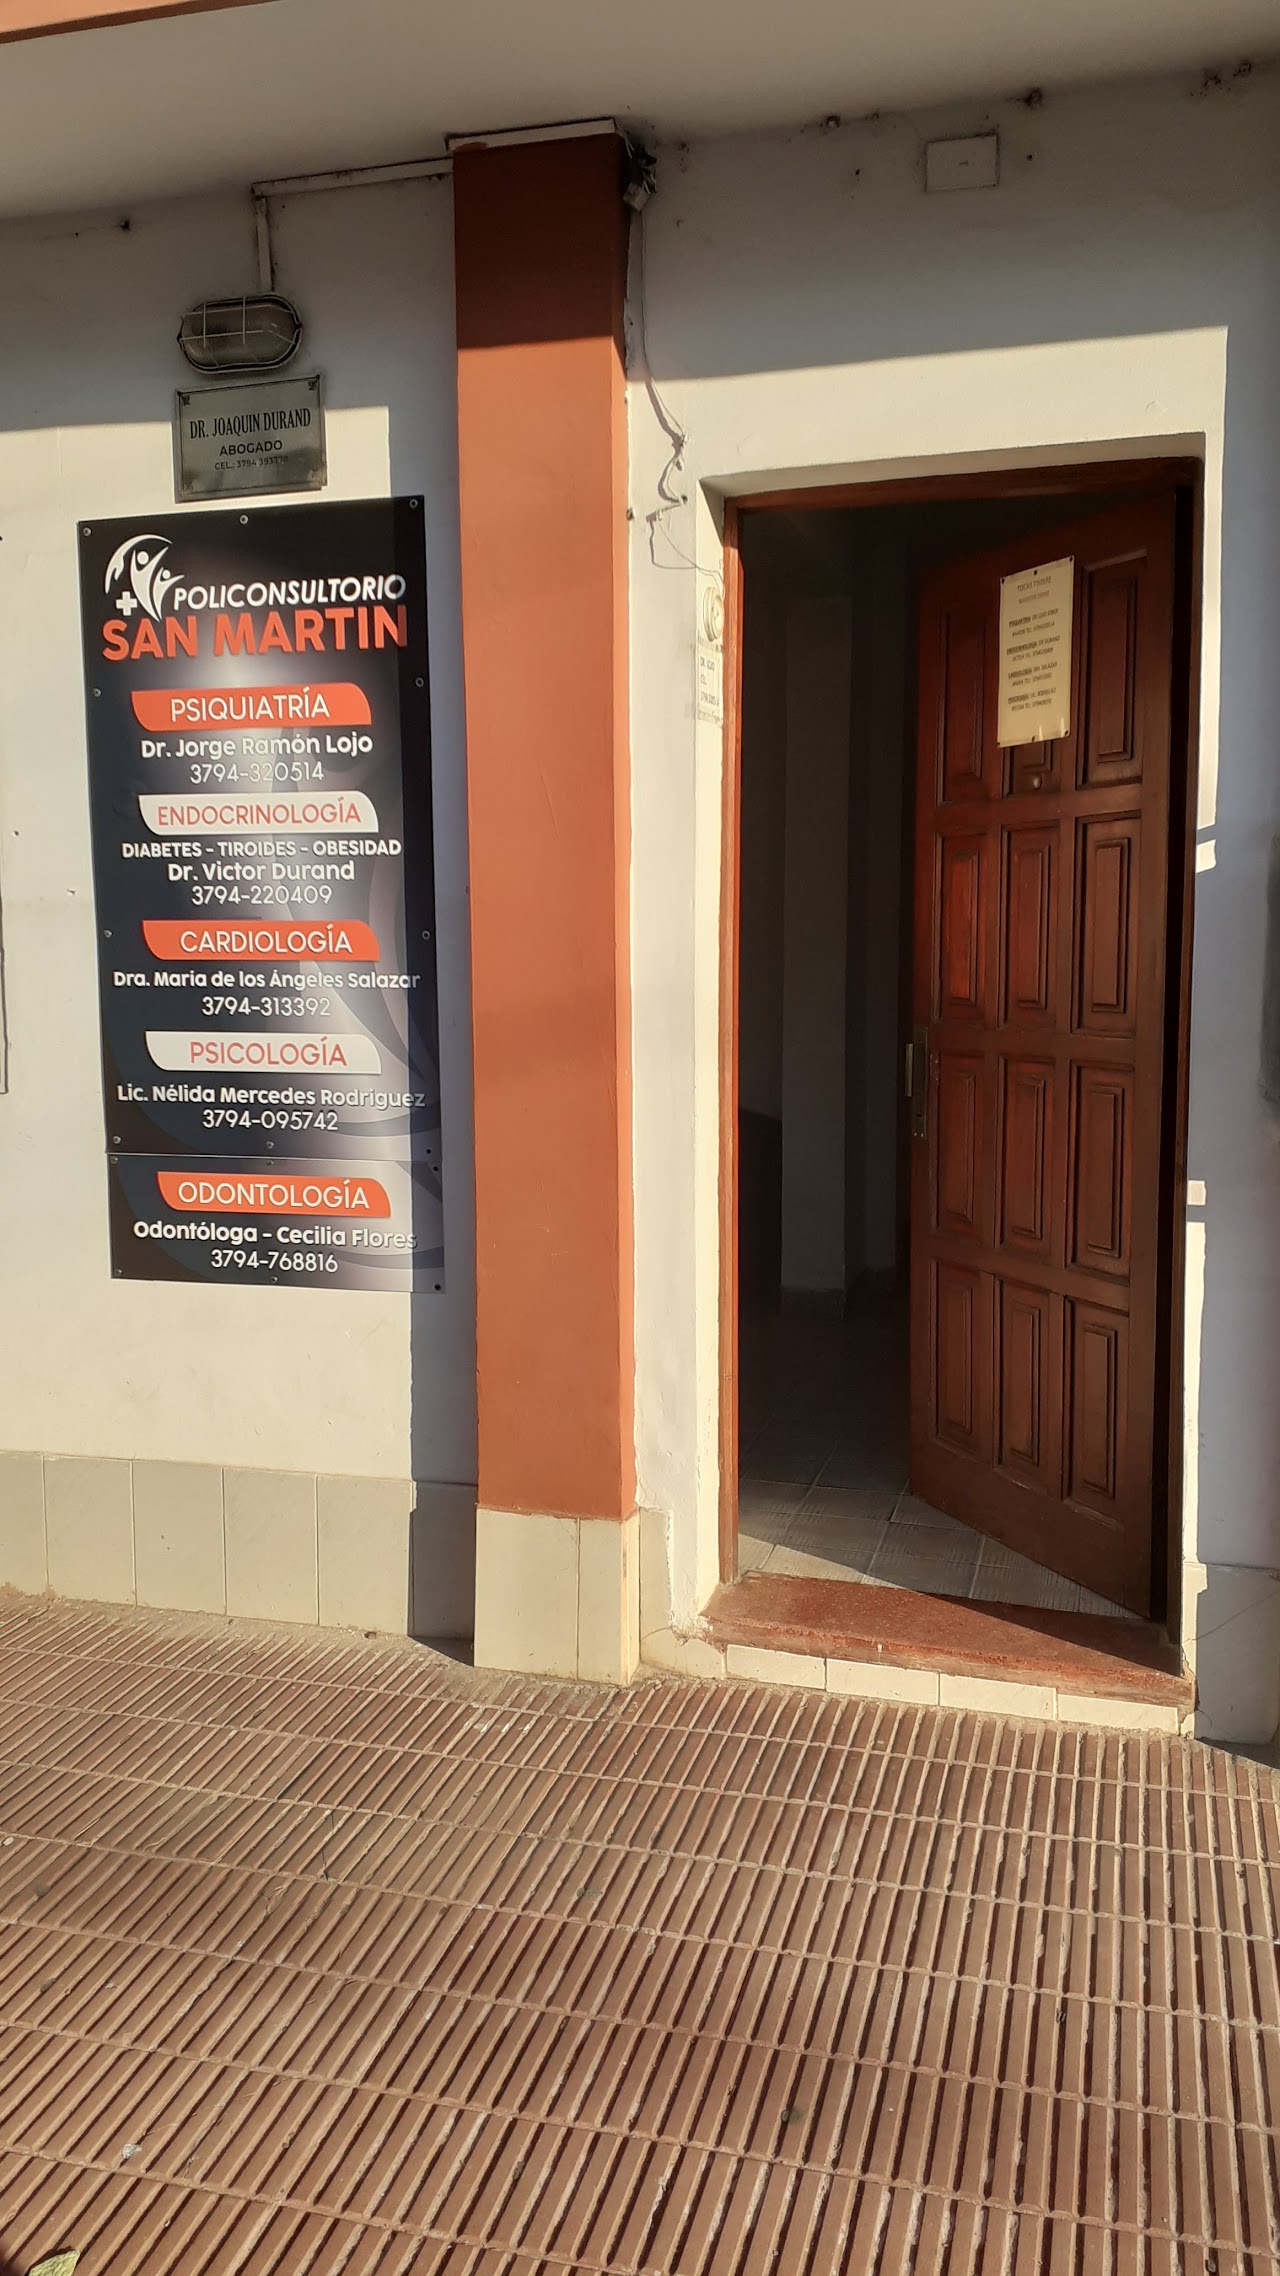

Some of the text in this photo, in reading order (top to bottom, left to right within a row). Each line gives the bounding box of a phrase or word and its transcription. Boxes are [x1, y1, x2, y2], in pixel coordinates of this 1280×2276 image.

[190, 408, 311, 439] DR. JOAQUIN DURAND
[219, 440, 283, 456] ABOGADO
[236, 460, 257, 468] 3794
[173, 574, 407, 611] POLICONSULTORIO
[102, 604, 408, 662] SAN MARTIN
[170, 685, 331, 723] PSIQUIATRÍA
[141, 732, 374, 762] Dr. Jorge Ramón Lojo
[189, 761, 325, 785] 3794-320514
[157, 797, 361, 827] ENDOCRINOLOGÍA
[122, 841, 202, 858] DIABETES
[217, 841, 297, 857] TIROIDES
[312, 839, 402, 856] OBESIDAD
[168, 860, 355, 881] Dr. Victor Durand
[191, 885, 333, 905] 3794-220409
[180, 924, 353, 955] CARDIOLOGÍA
[113, 969, 420, 991] Dra. Maria de los Ángeles Salazar
[201, 996, 331, 1017] 3794-313392
[189, 1036, 348, 1067] PSICOLOGÍA
[117, 1083, 426, 1110] Lic. Nélida Mercedes Rodriguez
[202, 1109, 339, 1131] 3794-095742
[177, 1179, 371, 1209] ODONTOLOGÍA
[133, 1220, 258, 1246] Odontóloga
[276, 1225, 346, 1246] Cecilia
[351, 1228, 417, 1249] Flores
[211, 1248, 339, 1273] 3794-768816
